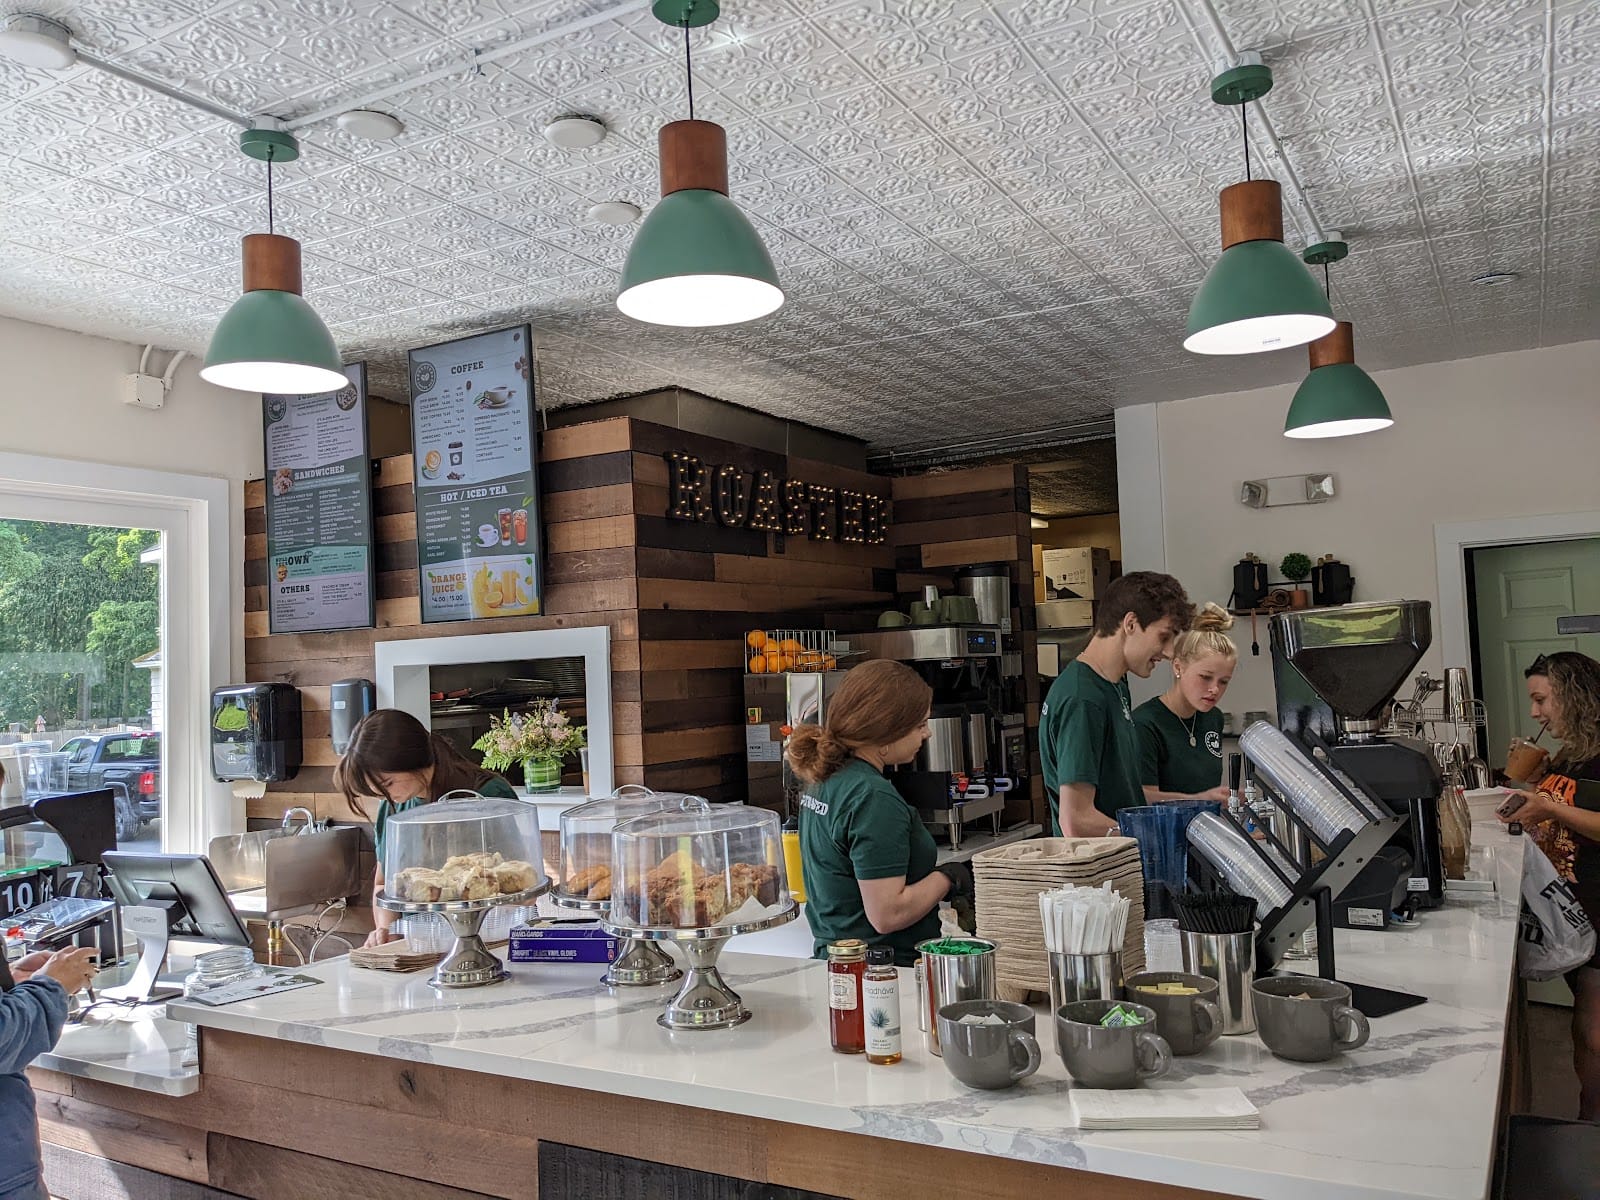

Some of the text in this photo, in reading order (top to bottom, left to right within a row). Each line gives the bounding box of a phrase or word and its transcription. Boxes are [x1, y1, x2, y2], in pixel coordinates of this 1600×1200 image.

[451, 361, 484, 374] COFFEE
[294, 465, 345, 480] SANDWICHES
[440, 485, 509, 502] HOT / ICED TEA
[287, 555, 310, 566] OWN
[431, 572, 468, 583] ORANGE
[280, 584, 311, 594] OTHERS
[431, 584, 455, 595] JUICE
[2, 882, 34, 913] 10
